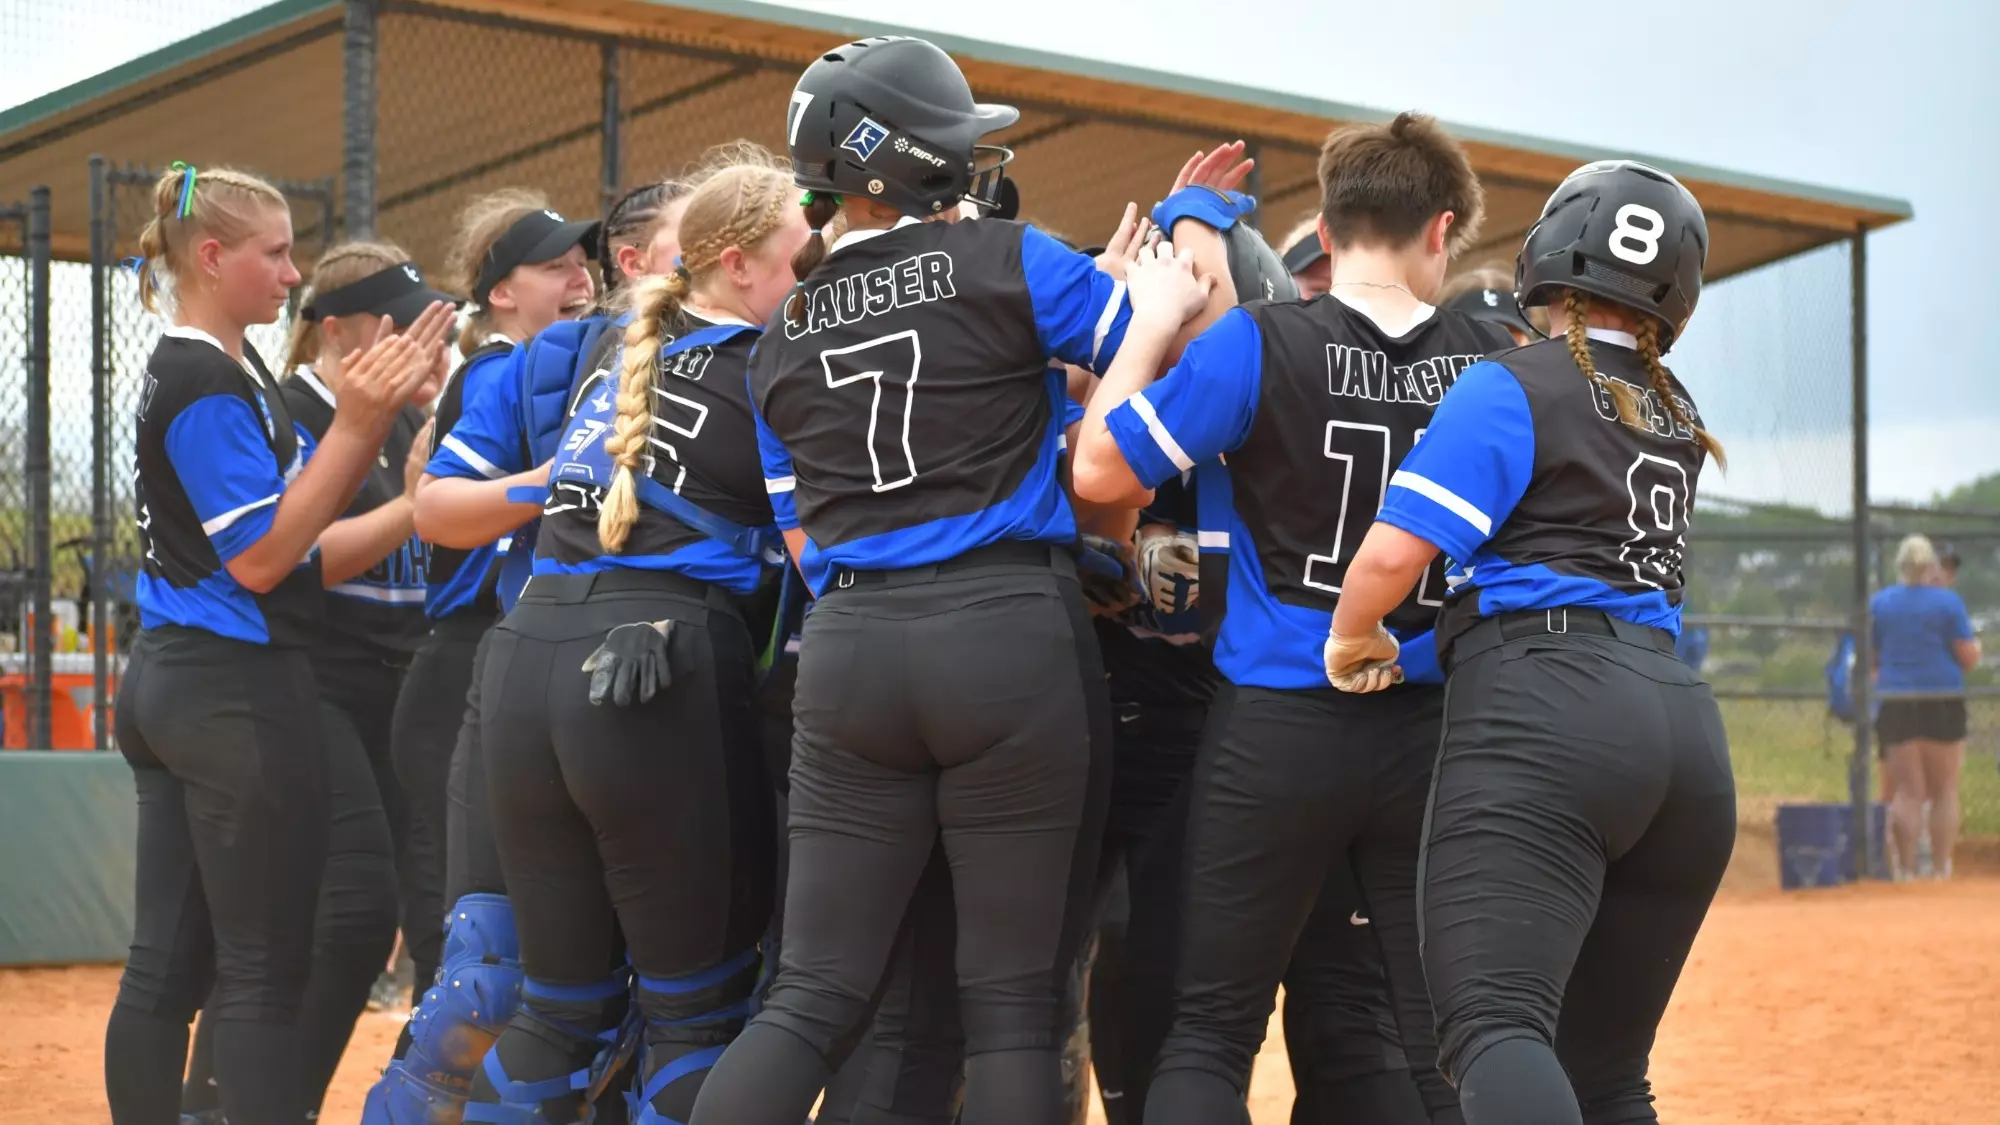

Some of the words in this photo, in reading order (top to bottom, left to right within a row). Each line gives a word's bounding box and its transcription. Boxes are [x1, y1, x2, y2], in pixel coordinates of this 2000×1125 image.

[789, 90, 815, 147] 7
[1608, 203, 1665, 265] 8
[784, 251, 956, 341] SAUSER
[820, 329, 922, 493] 7
